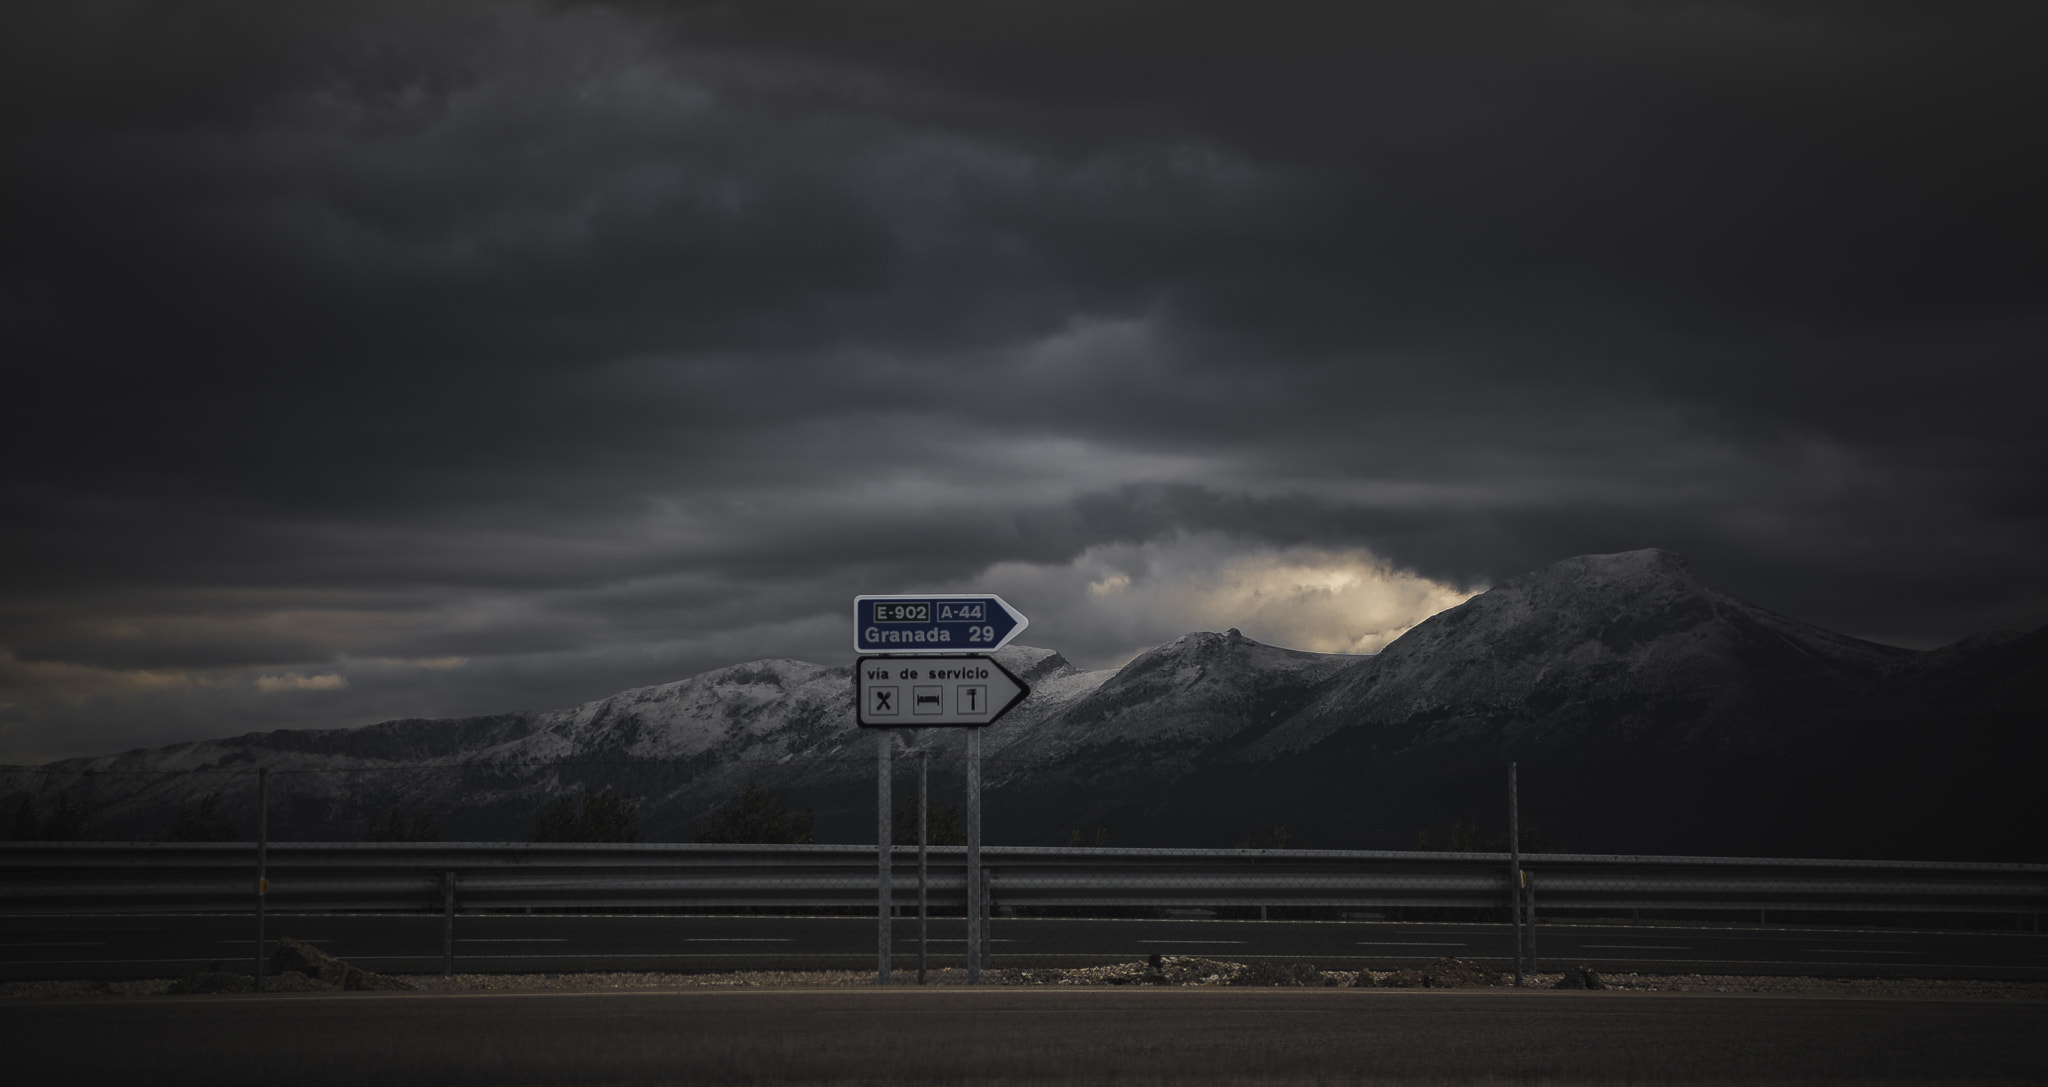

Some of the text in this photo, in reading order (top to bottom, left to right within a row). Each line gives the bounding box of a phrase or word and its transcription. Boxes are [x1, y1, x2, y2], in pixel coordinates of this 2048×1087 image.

[877, 605, 982, 620] E-902 A-44
[865, 626, 995, 643] Granada 29
[900, 668, 918, 679] de
[929, 667, 989, 679] servicio
